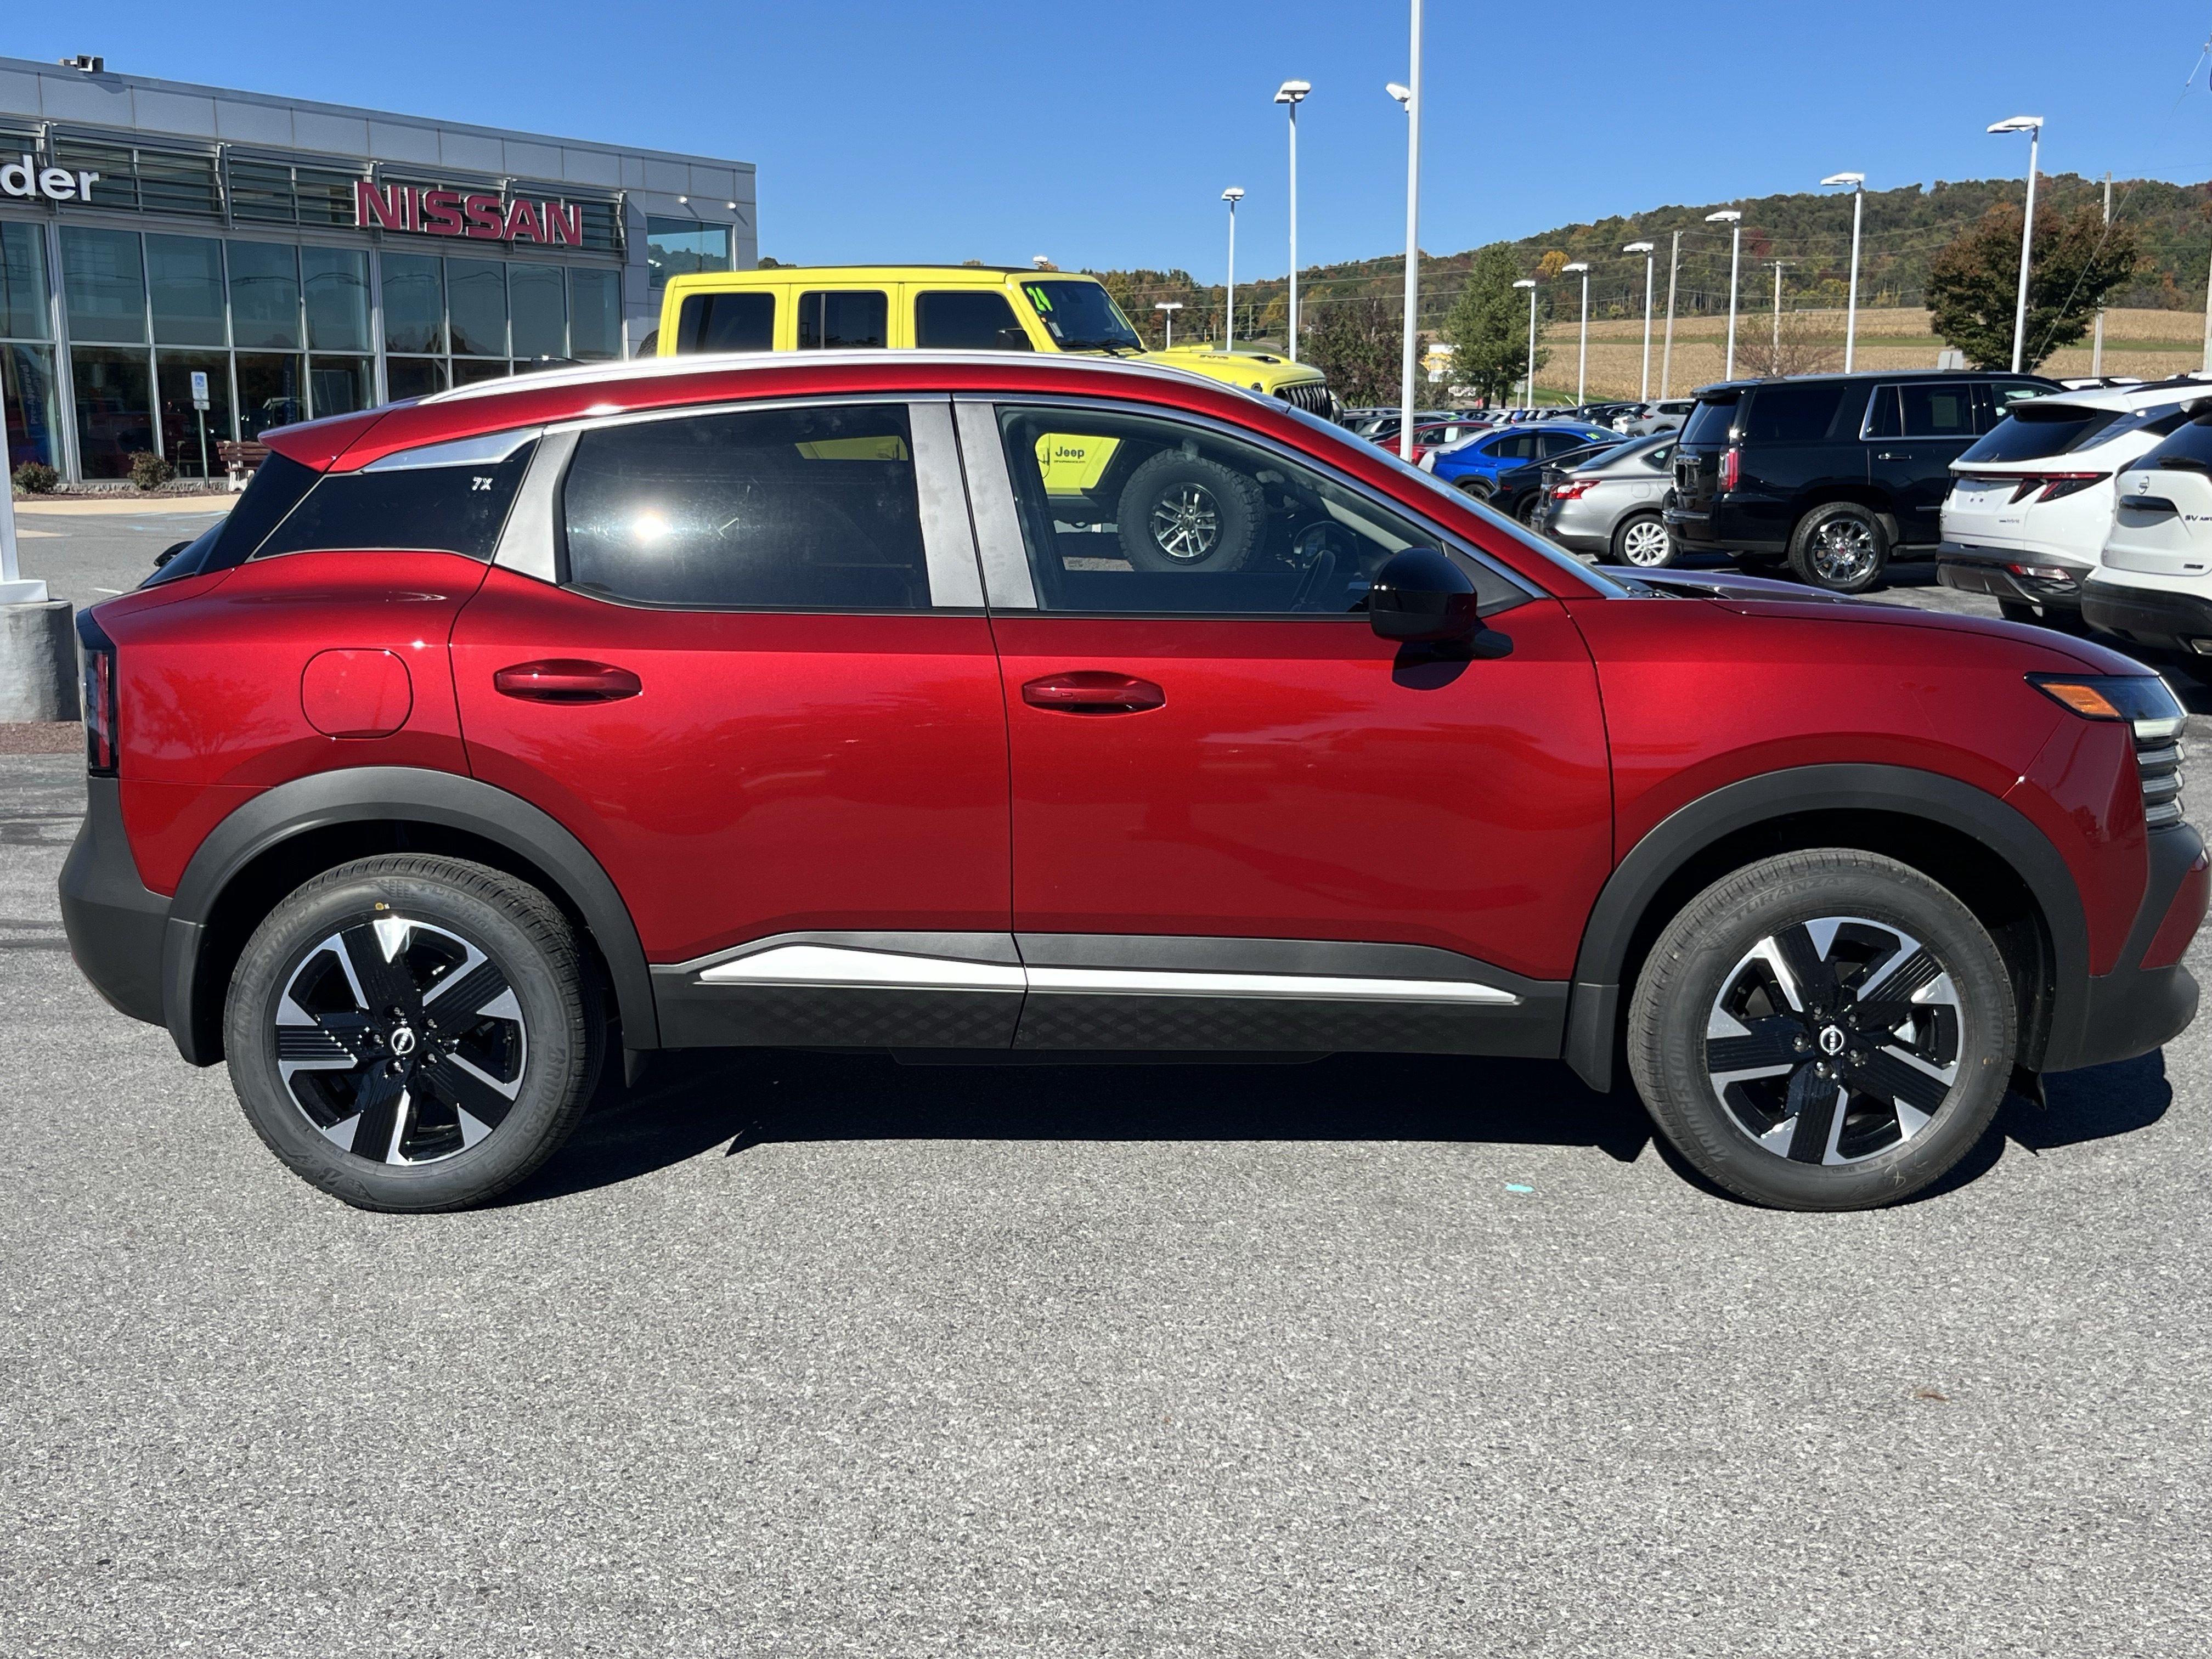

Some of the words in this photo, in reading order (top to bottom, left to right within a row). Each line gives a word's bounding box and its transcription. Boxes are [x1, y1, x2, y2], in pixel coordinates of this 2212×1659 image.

[0, 154, 100, 202] der
[354, 181, 583, 247] NISSAN
[1055, 446, 1085, 459] Jeep
